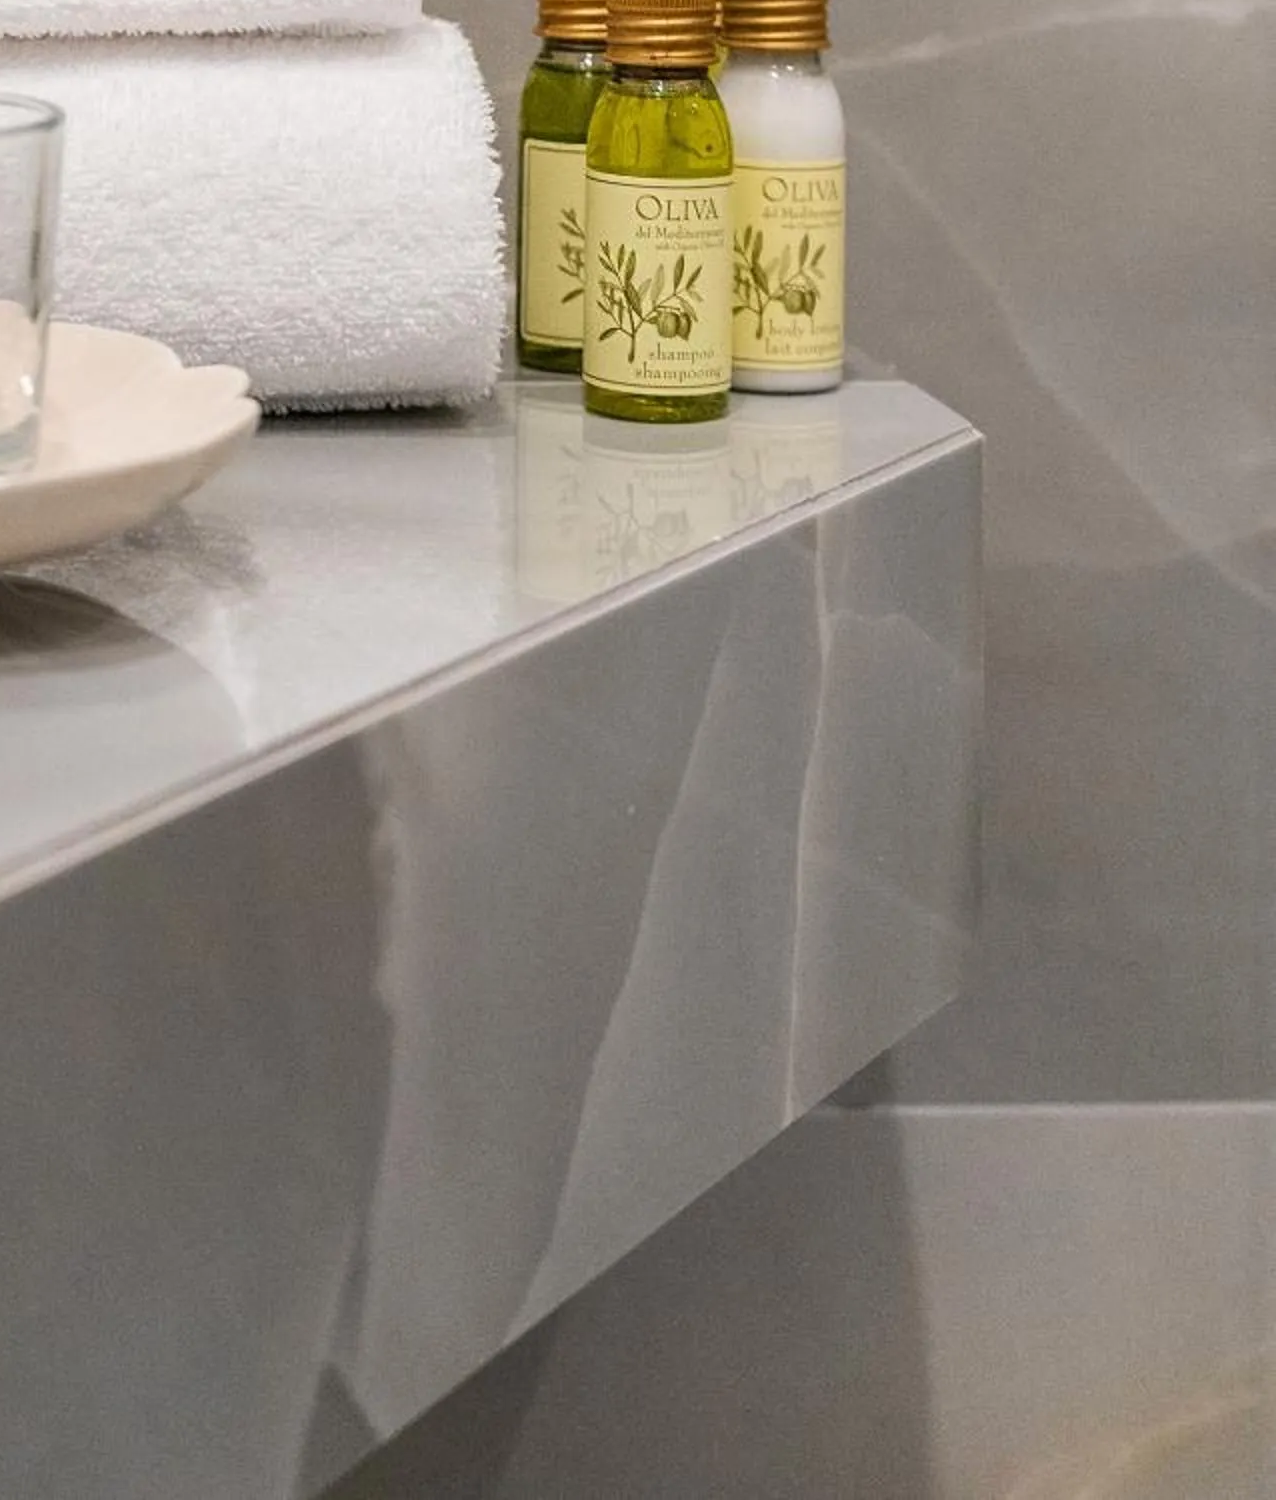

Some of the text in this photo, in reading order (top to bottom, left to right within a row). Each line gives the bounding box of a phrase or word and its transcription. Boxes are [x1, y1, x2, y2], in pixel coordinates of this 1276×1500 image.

[761, 177, 839, 202] OLIVA
[635, 194, 719, 221] OLIVA
[648, 342, 715, 365] shampoo
